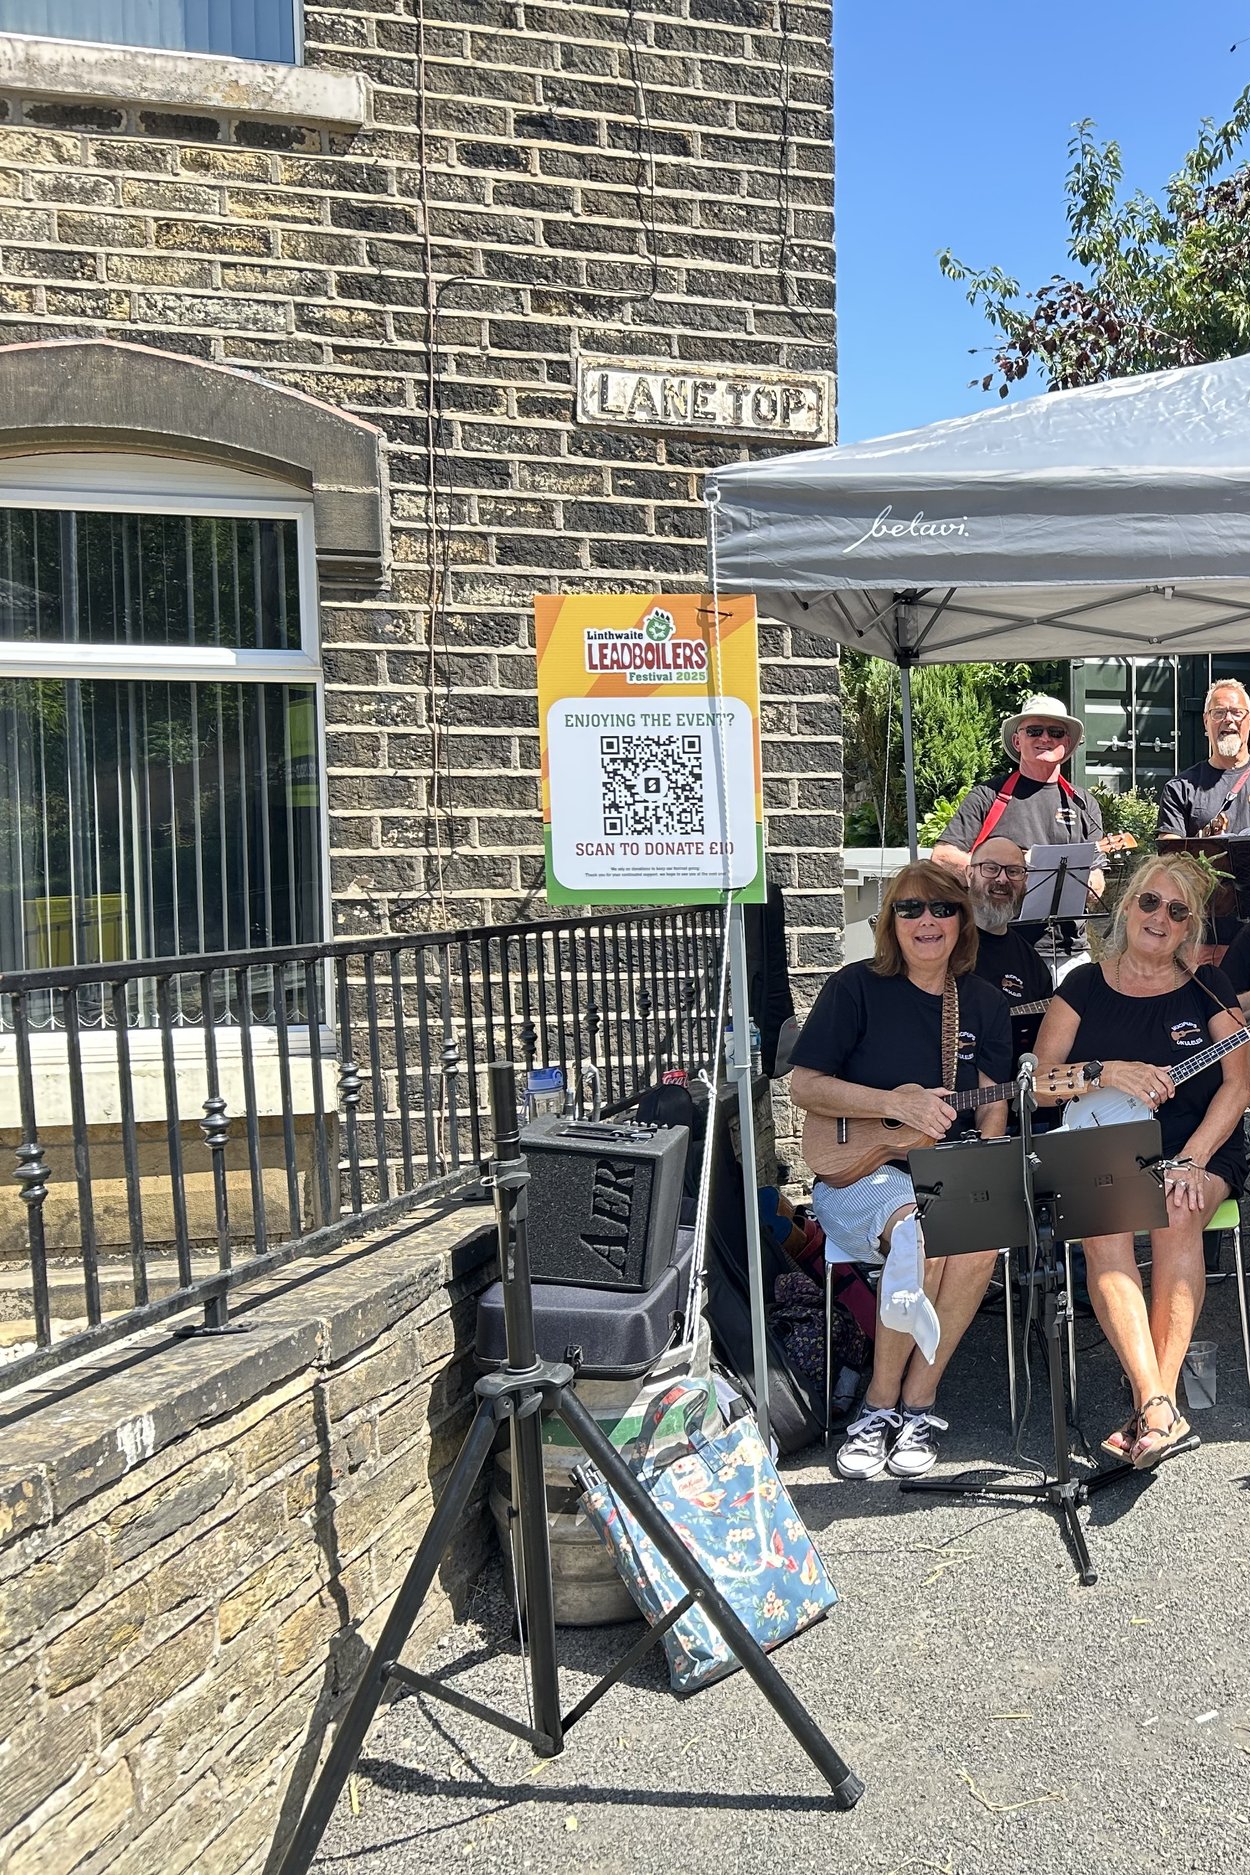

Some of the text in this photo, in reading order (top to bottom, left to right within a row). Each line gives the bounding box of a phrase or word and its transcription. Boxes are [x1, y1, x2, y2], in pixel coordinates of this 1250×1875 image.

[600, 373, 809, 429] LANE TOP
[586, 630, 644, 640] Linthwaite
[587, 642, 707, 670] LEADBOILERS
[629, 671, 706, 682] Festival 2025
[564, 712, 735, 727] ENJOYING THE EVENT?
[575, 843, 615, 857] SCAN
[620, 843, 640, 856] TO
[645, 842, 704, 856] DONATE
[580, 1160, 636, 1278] AER
